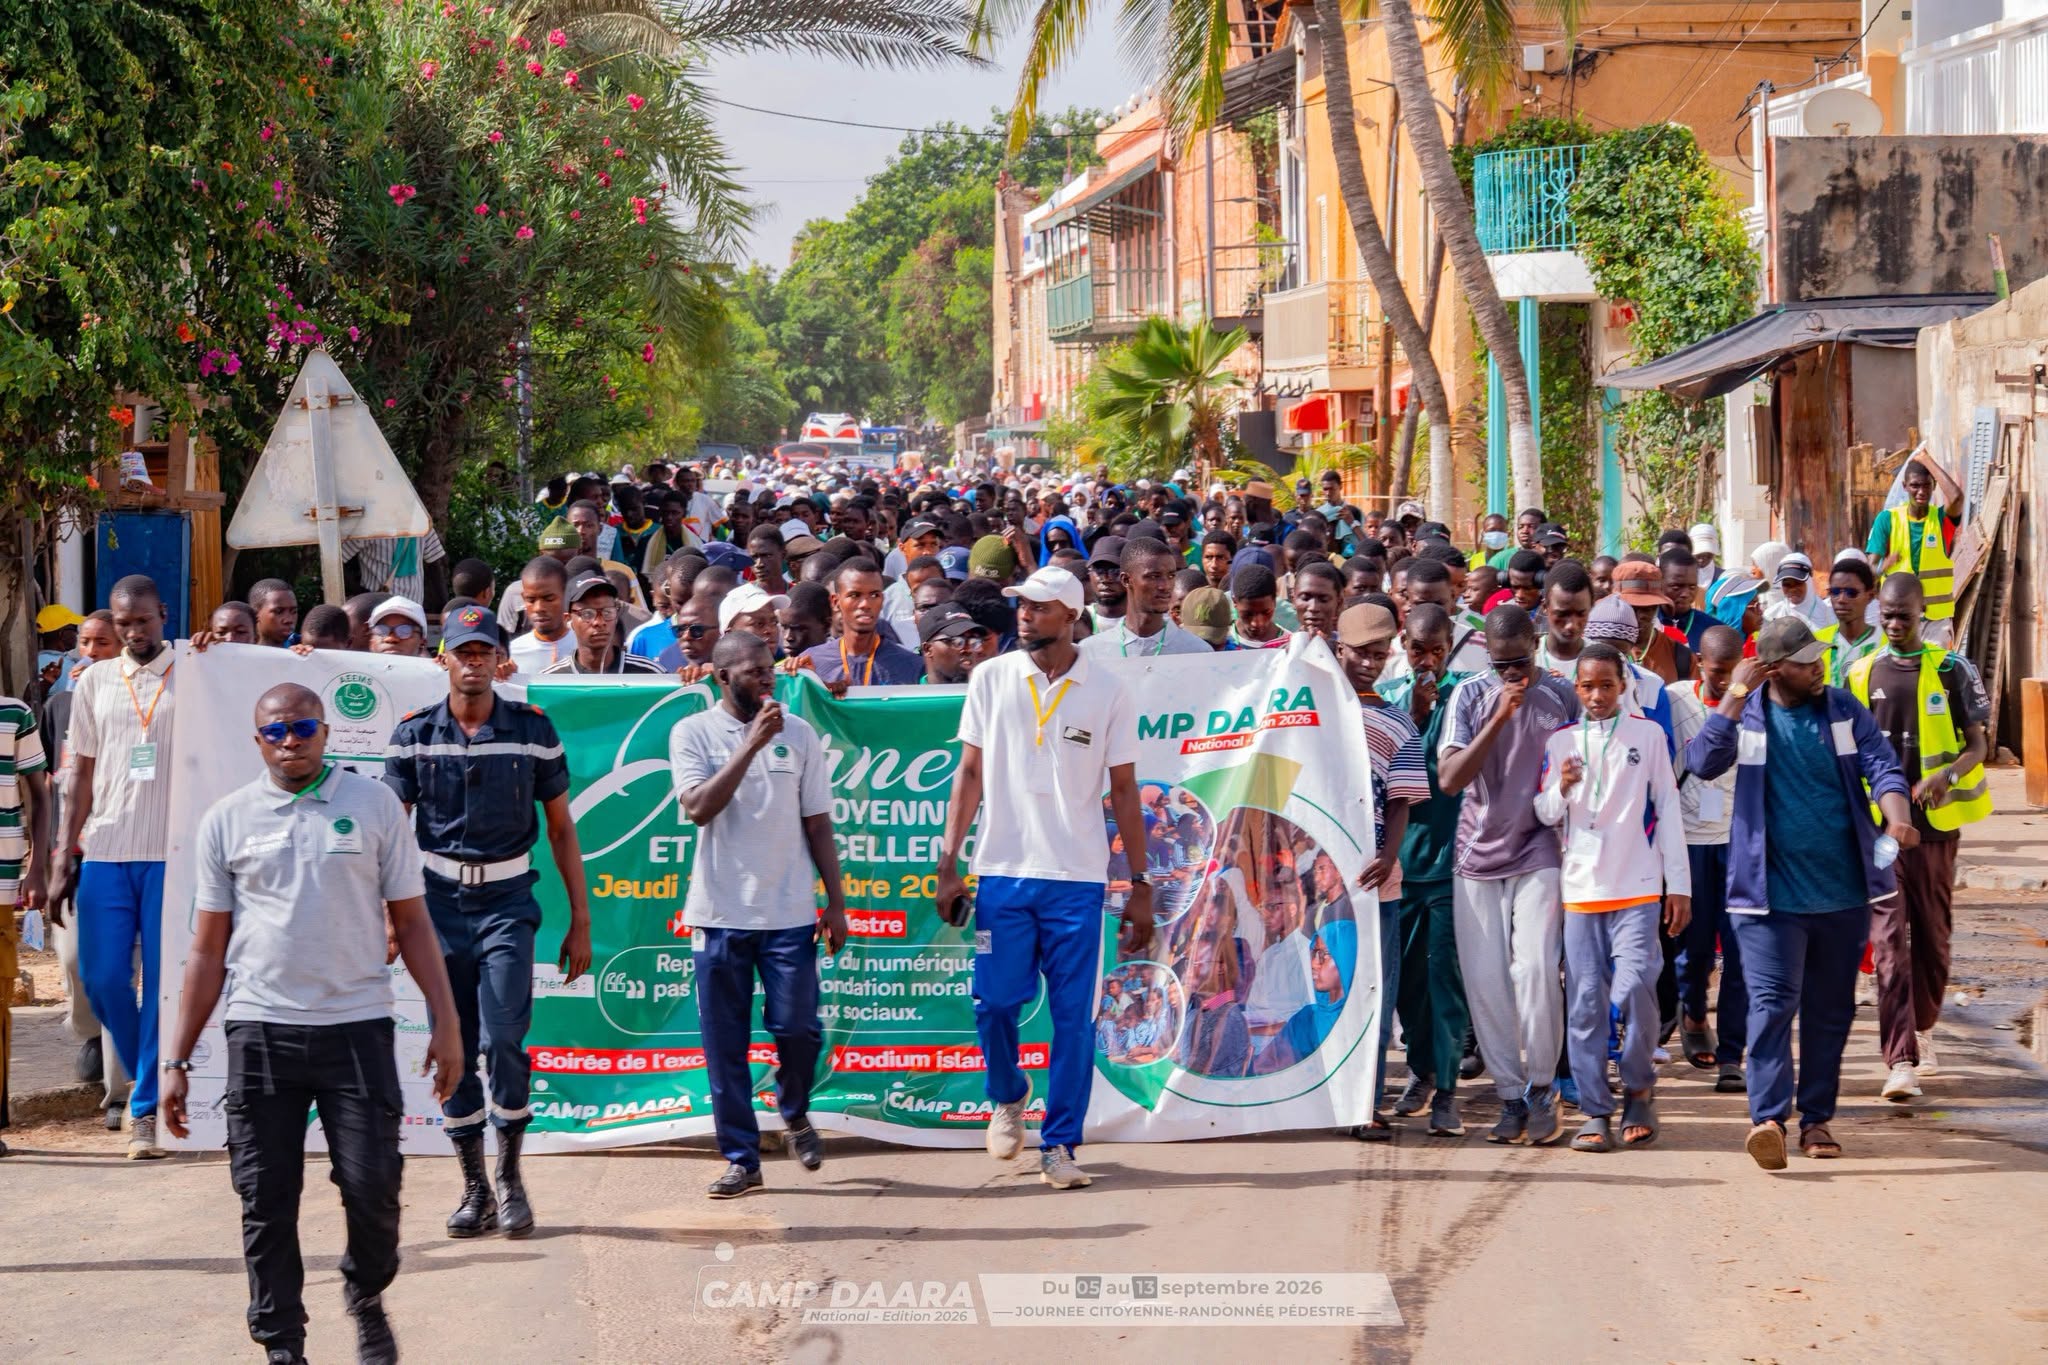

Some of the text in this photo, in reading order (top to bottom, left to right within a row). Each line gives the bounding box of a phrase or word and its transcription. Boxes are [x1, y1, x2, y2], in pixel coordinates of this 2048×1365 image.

[339, 674, 374, 686] AEEMS
[1138, 712, 1195, 741] MP
[1279, 713, 1312, 726] 2026
[1187, 736, 1244, 753] National
[649, 836, 692, 863] ET
[592, 873, 679, 899] Jeudi
[839, 950, 861, 972] du
[654, 976, 973, 1001] pas ondation moral
[843, 1002, 924, 1021] sociaux.
[537, 1051, 612, 1071] Soirée
[617, 1053, 647, 1071] de
[845, 1050, 930, 1070] Podium
[528, 1101, 599, 1120] CAMP
[602, 1094, 692, 1119] DAARA
[888, 1091, 953, 1114] CAMP
